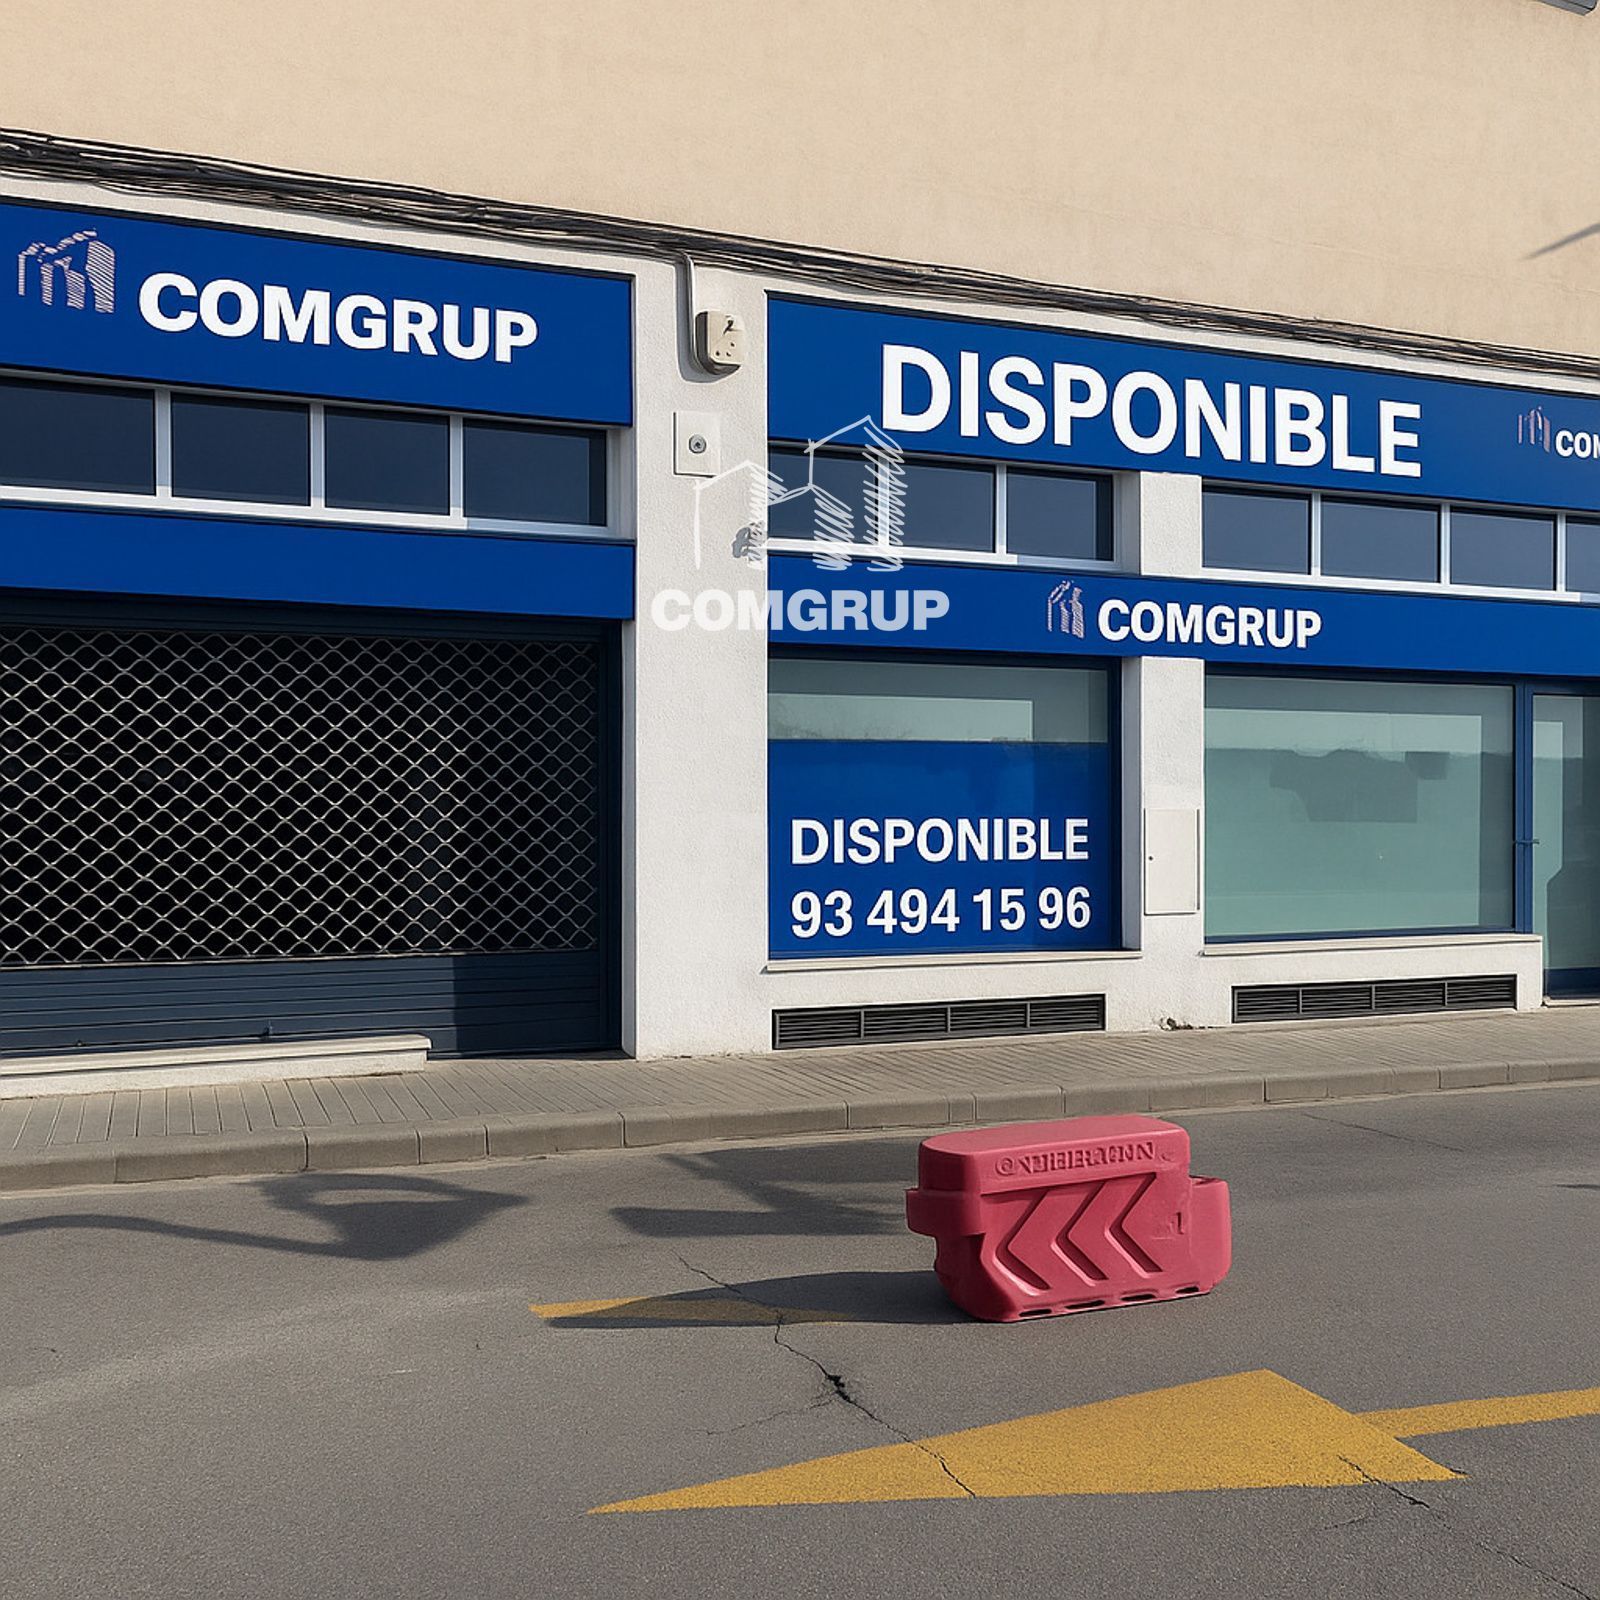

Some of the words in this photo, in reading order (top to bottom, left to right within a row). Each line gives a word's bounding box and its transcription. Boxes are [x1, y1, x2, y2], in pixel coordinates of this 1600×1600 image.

[138, 272, 538, 364] COMGRUP
[881, 343, 1422, 478] DISPONIBLE
[1098, 599, 1322, 649] COMGRUP
[791, 818, 1089, 865] DISPONIBLE
[791, 890, 854, 939] 93
[866, 888, 960, 935] 494
[972, 888, 1026, 932] 15
[1038, 886, 1092, 930] 96
